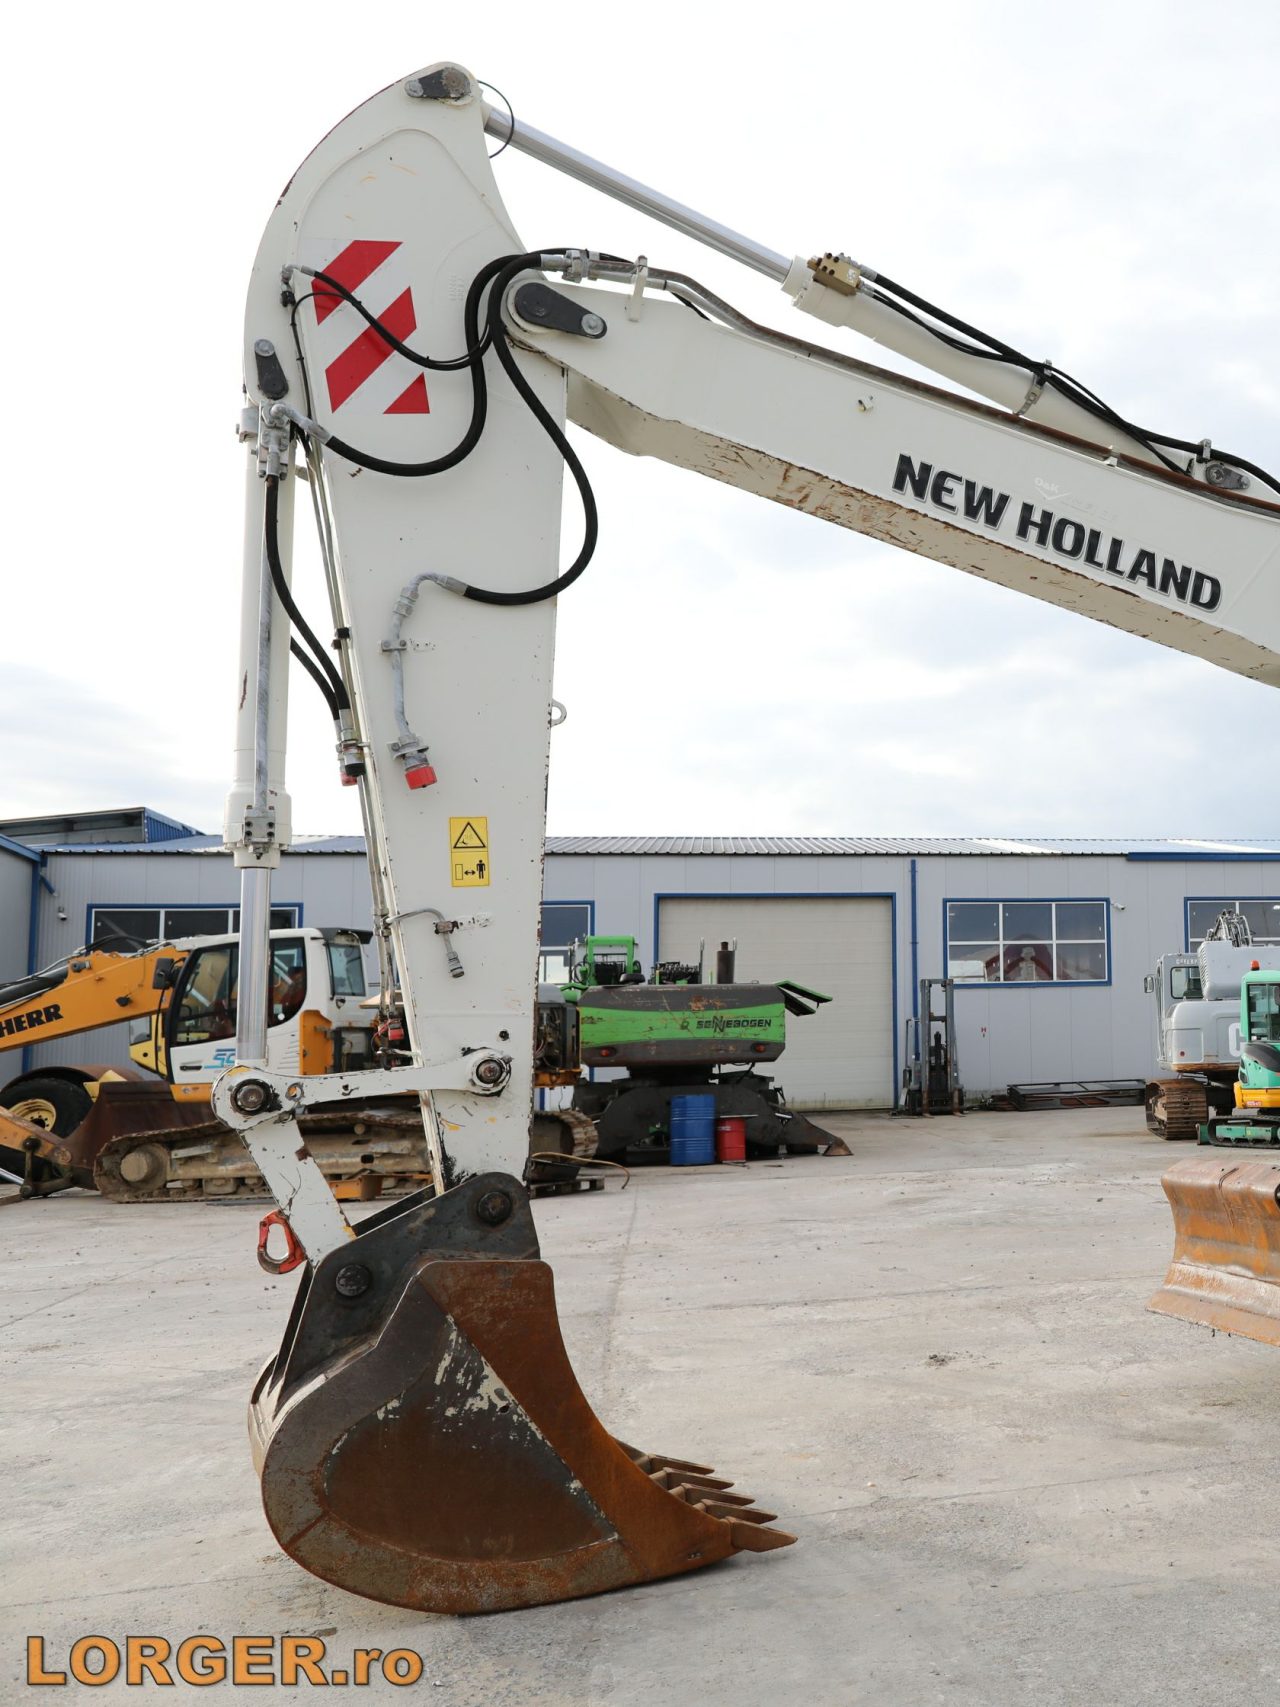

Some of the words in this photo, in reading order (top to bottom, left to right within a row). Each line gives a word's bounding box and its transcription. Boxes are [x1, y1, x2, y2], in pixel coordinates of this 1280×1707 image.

[892, 452, 1011, 530] NEW
[1016, 500, 1222, 612] HOLLAND
[0, 1003, 65, 1038] HERR
[696, 1015, 772, 1033] SENNEBOGEN
